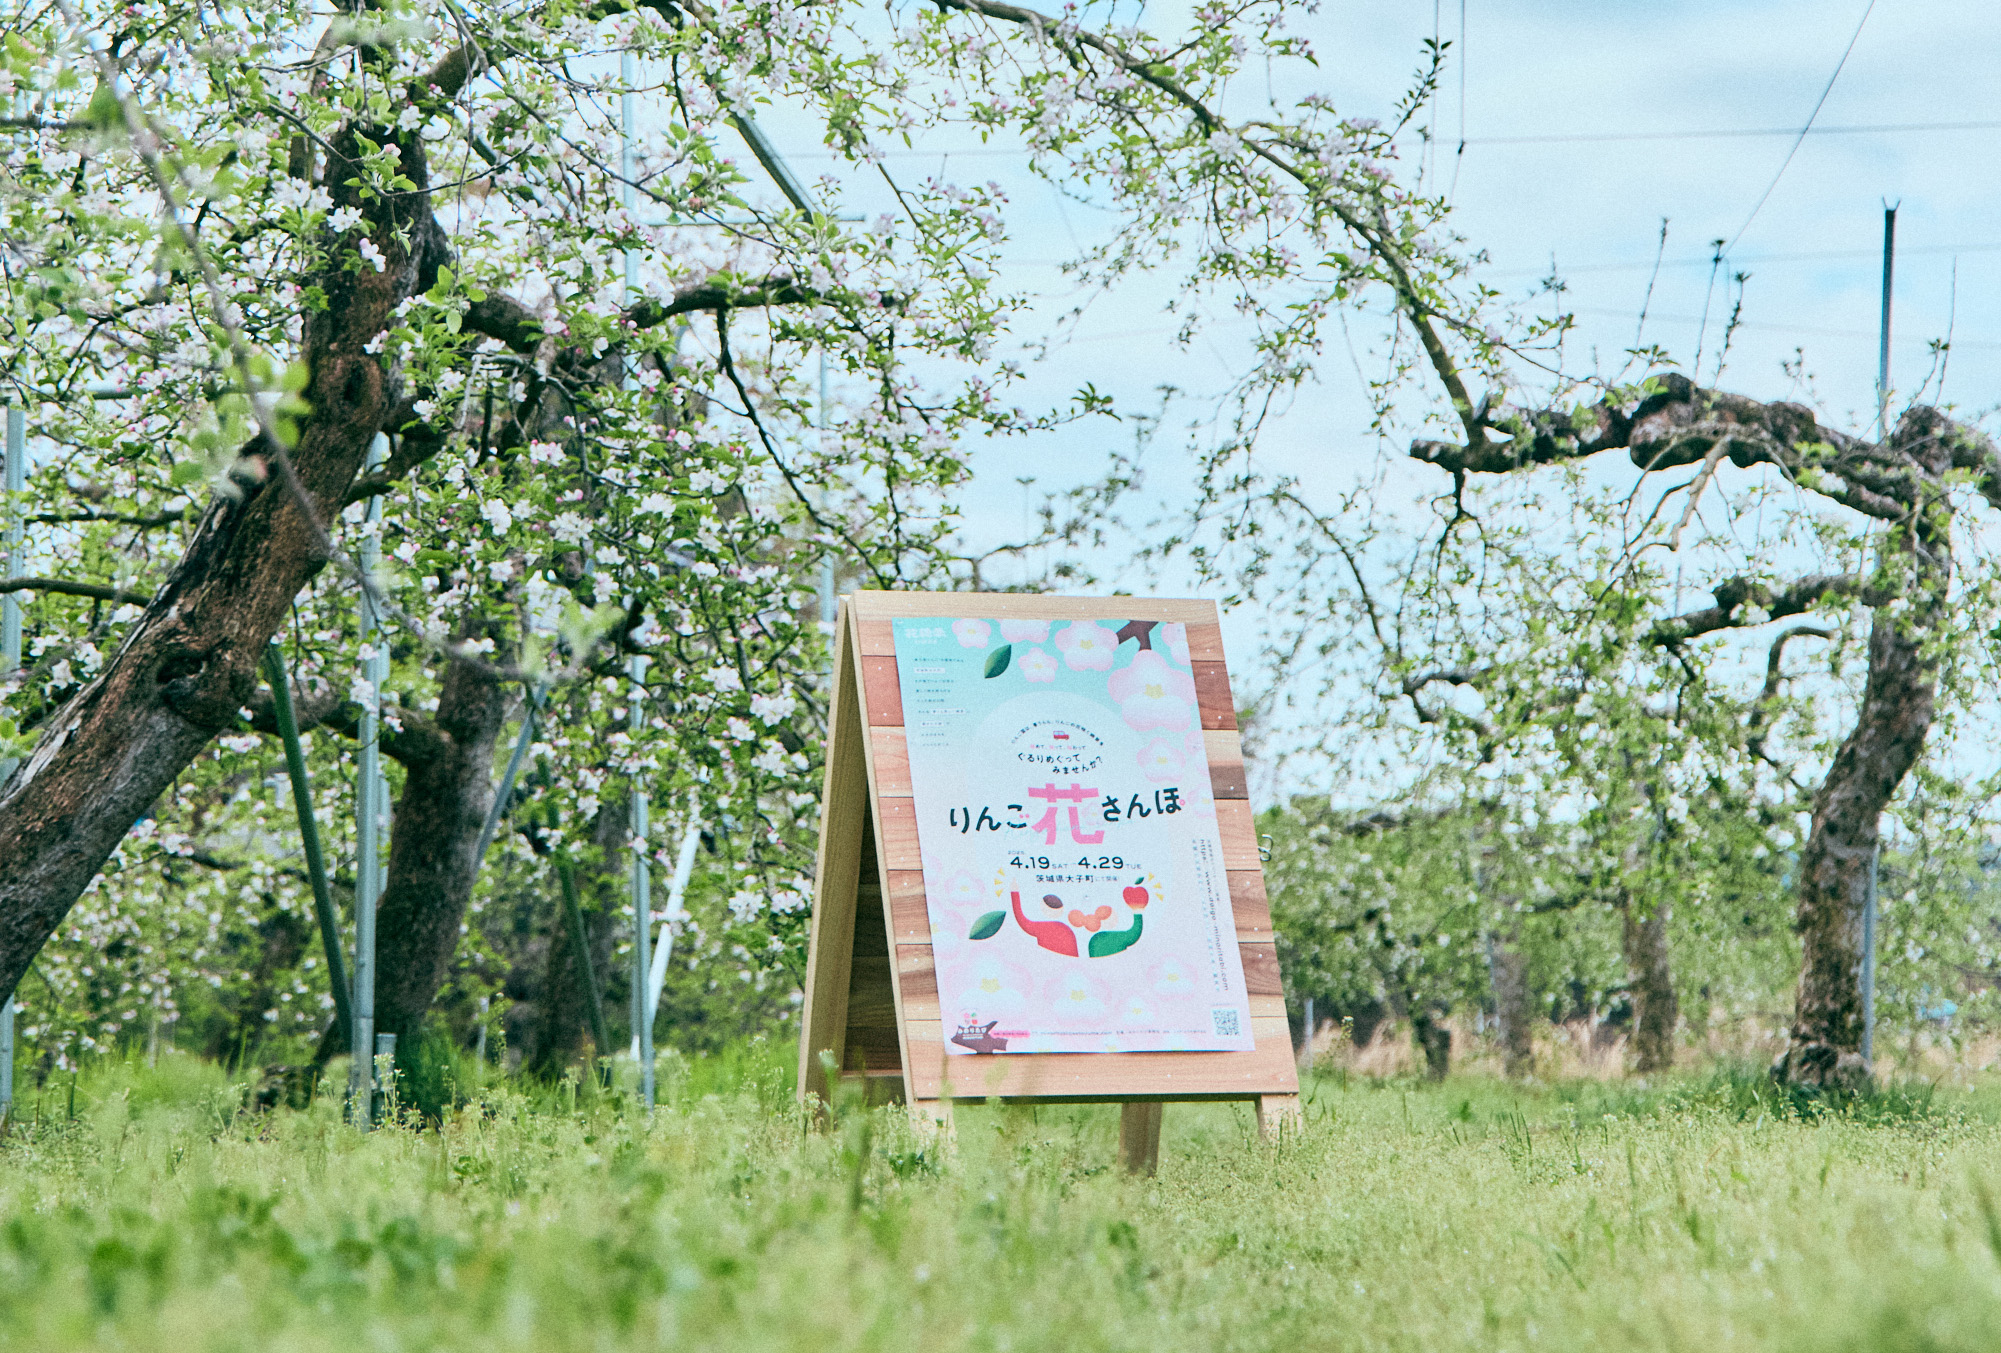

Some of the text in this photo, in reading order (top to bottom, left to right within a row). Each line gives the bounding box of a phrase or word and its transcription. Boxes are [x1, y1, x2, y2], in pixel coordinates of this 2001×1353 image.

[1018, 752, 1080, 763] ぐるりめぐって
[1010, 856, 1050, 869] 4.19
[1078, 856, 1124, 869] 4.29
